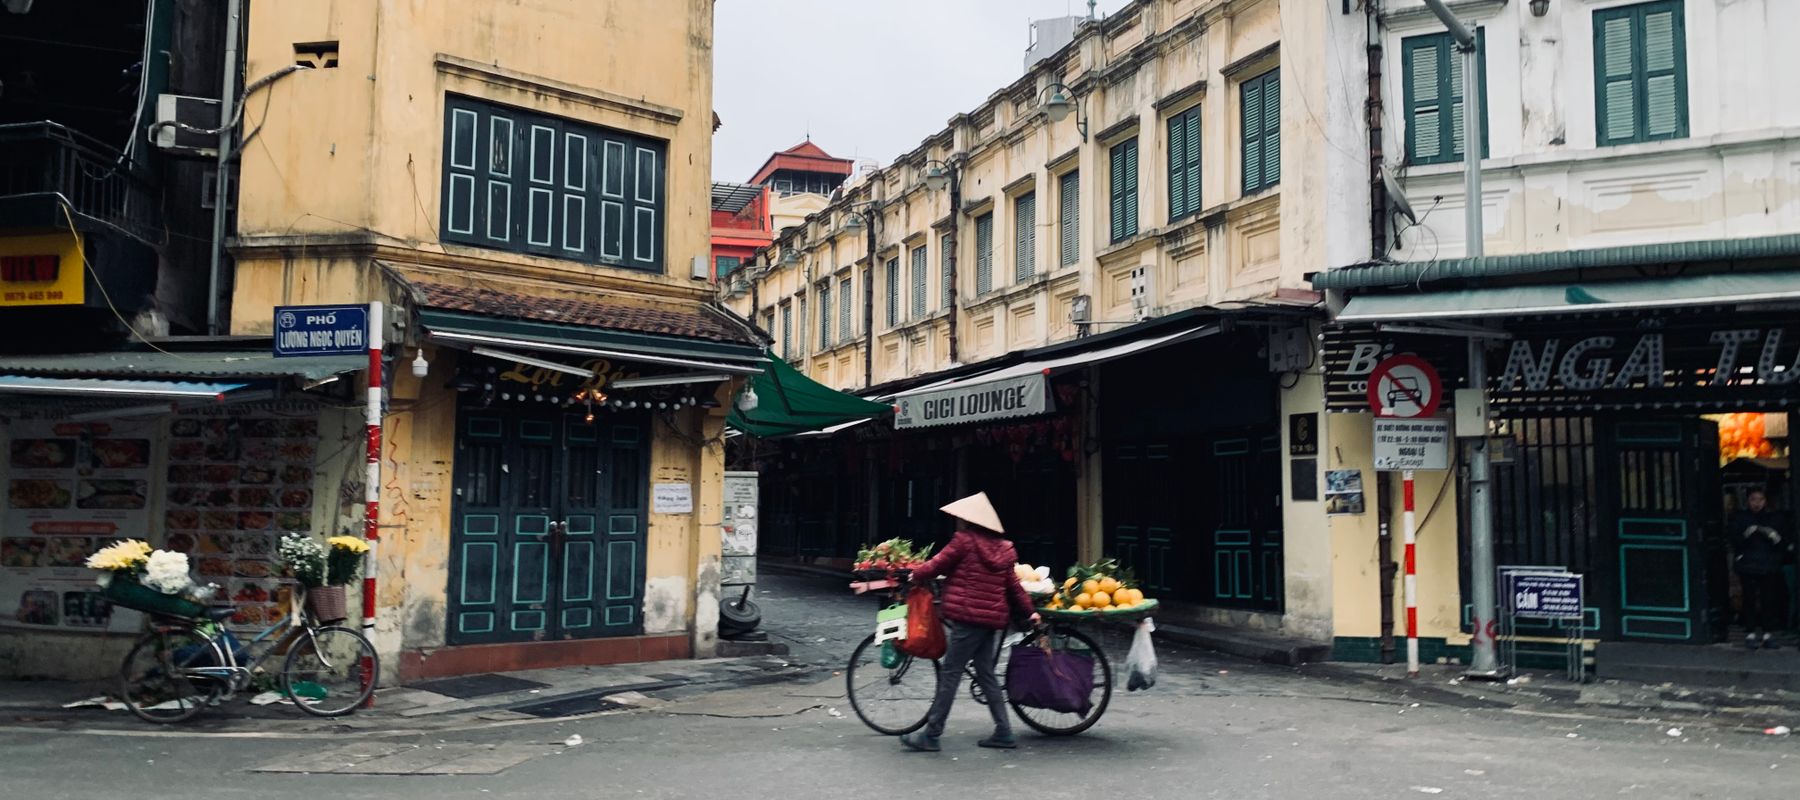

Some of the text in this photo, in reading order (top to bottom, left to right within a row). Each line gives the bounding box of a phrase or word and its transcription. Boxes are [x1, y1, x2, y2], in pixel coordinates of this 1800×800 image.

[306, 311, 337, 325] PHỐ
[309, 330, 333, 350] NGỌC
[334, 324, 362, 348] QUYẾN
[923, 385, 1026, 420] CICI LOUNGE
